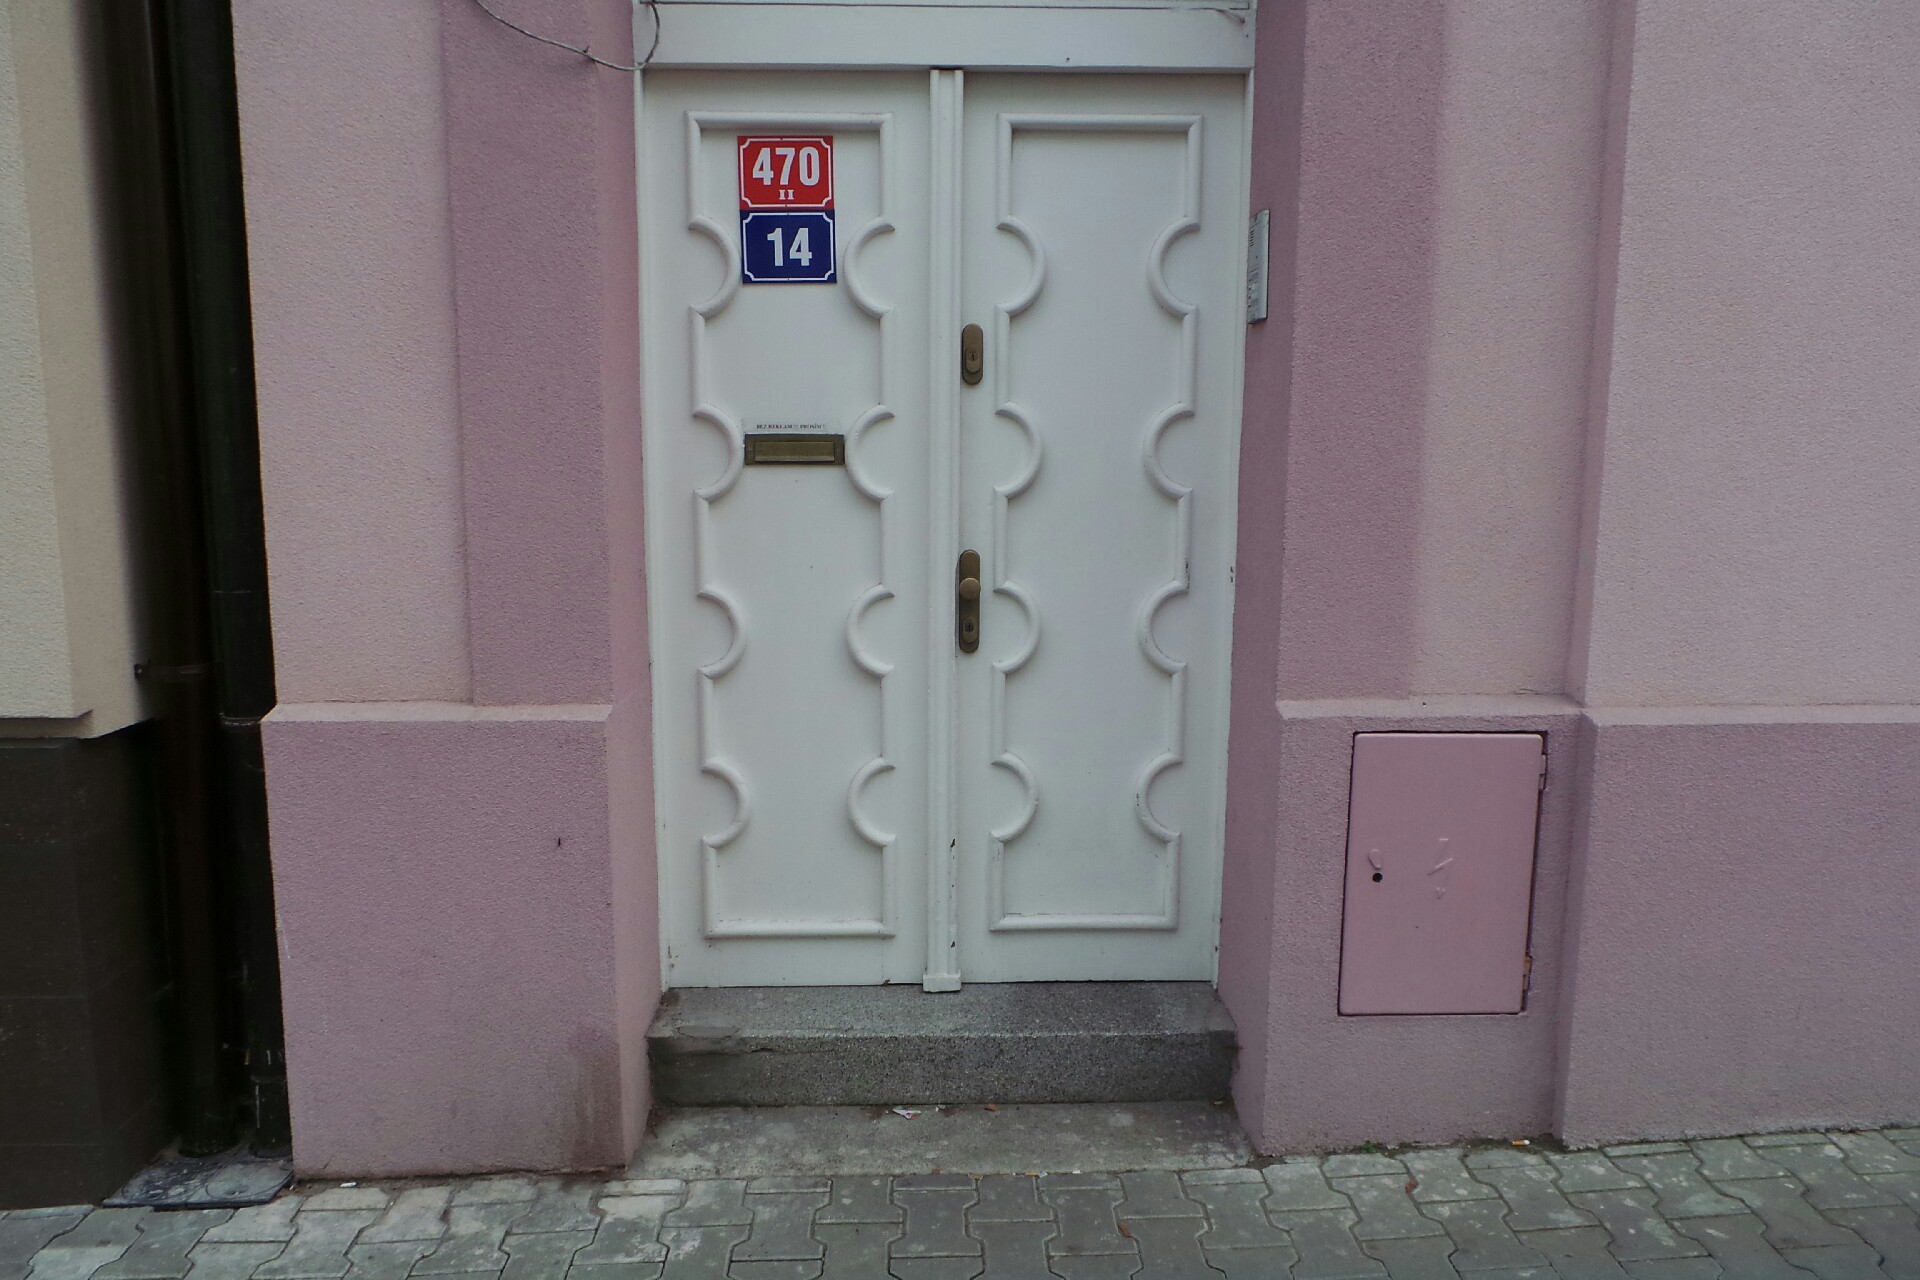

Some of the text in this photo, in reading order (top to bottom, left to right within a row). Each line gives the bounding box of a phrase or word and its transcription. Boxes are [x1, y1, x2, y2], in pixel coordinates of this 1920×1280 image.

[752, 146, 820, 186] 470
[778, 189, 795, 201] II
[767, 227, 813, 267] 14
